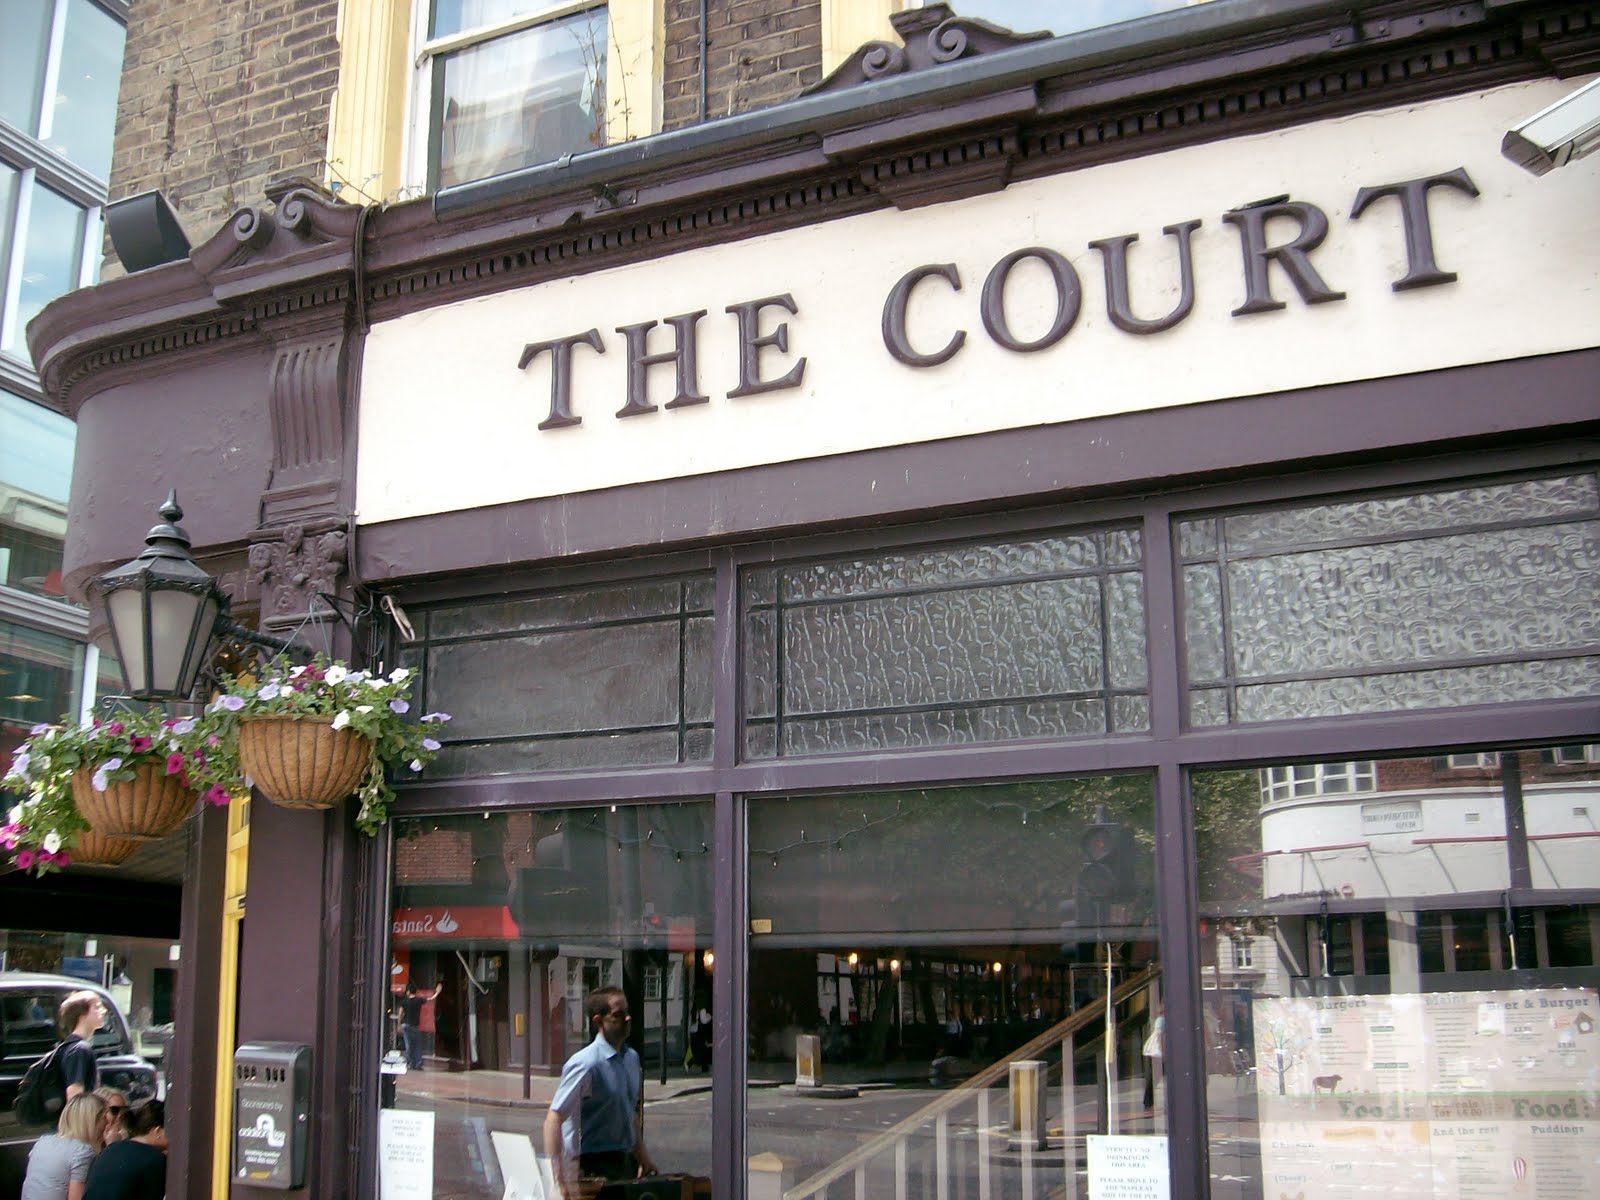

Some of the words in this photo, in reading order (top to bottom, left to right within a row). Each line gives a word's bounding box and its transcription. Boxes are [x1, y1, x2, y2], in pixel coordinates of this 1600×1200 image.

[517, 292, 808, 431] THE
[880, 166, 1481, 369] COURT
[1315, 1000, 1368, 1012] Burgers
[1539, 997, 1590, 1010] Burger
[1512, 1097, 1591, 1119] Food:
[1531, 1125, 1585, 1136] Puddings
